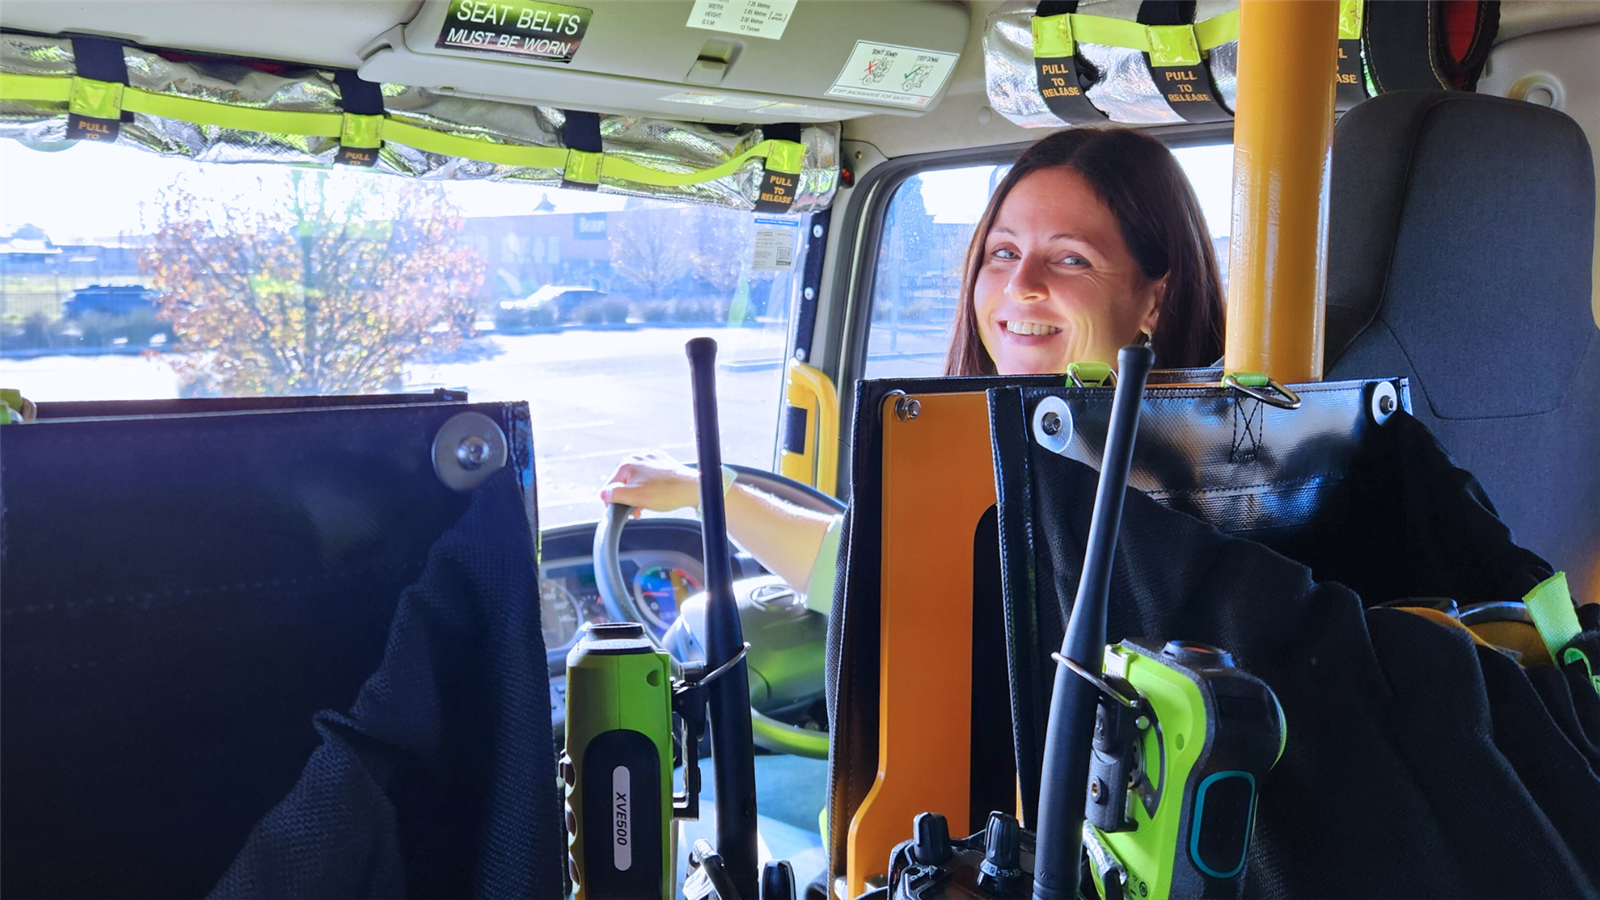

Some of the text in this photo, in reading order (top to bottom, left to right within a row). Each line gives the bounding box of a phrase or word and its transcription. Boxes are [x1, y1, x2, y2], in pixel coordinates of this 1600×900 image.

[457, 0, 581, 36] SEAT BELTS
[447, 28, 571, 56] MUST BE WORN
[1042, 64, 1069, 75] PULL
[1051, 77, 1065, 87] TO
[1165, 71, 1198, 82] PULL
[1042, 86, 1080, 98] RELEASE
[1177, 83, 1193, 93] TO
[1167, 93, 1212, 103] RELEASE
[78, 121, 110, 133] PULL
[345, 151, 371, 161] PULL
[770, 175, 793, 187] PULL
[774, 186, 785, 195] TO
[761, 192, 793, 204] RELEASE
[616, 791, 627, 846] XVE500
